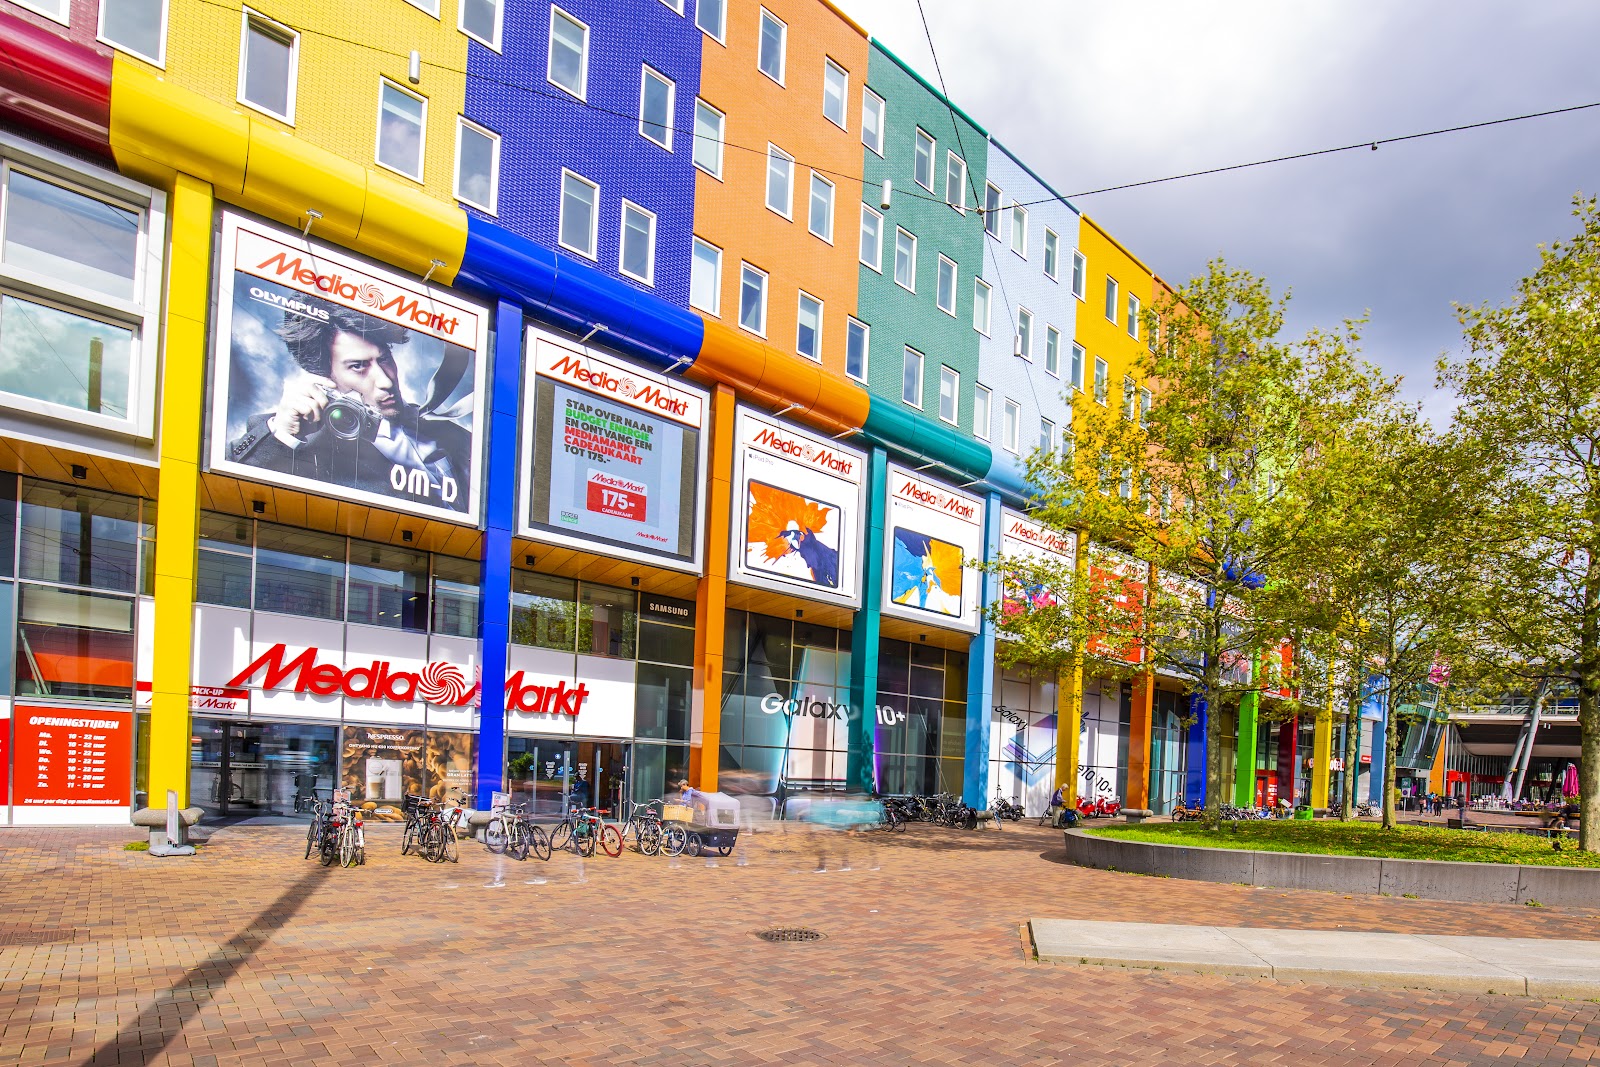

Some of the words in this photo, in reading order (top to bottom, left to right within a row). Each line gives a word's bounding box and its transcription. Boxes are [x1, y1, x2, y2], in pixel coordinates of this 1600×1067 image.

[249, 287, 330, 320] OLYMPUS
[256, 252, 360, 301] Media
[378, 295, 460, 336] Markt
[550, 355, 619, 393] Media
[633, 385, 689, 416] Markt
[565, 408, 607, 428] BUDGET
[609, 421, 650, 442] ENERGIE
[566, 399, 593, 413] STAP
[595, 408, 622, 424] OVER
[624, 418, 654, 434] NAAR
[564, 426, 637, 454] MEDIAMARKT
[565, 417, 579, 428] EN
[581, 422, 633, 445] ONTVANG
[635, 439, 652, 451] EEN
[564, 435, 643, 465] CADEAUKAART
[564, 444, 585, 457] TOT
[587, 450, 611, 464] 175.-
[753, 428, 802, 457] Media
[812, 450, 852, 475] Markt
[390, 463, 458, 503] OM-D
[592, 473, 617, 486] Media
[623, 482, 645, 493] Markt
[900, 481, 936, 504] Media
[944, 498, 974, 518] Markt
[1010, 522, 1038, 541] Media
[649, 602, 689, 616] SAMSUNG
[225, 643, 420, 702] Media
[192, 687, 224, 696] PICK-UP
[199, 698, 237, 710] Markt
[29, 716, 119, 729] OPENINGSTIJDEN
[995, 705, 1028, 731] Galaxy
[366, 732, 404, 740] NESPRESSO
